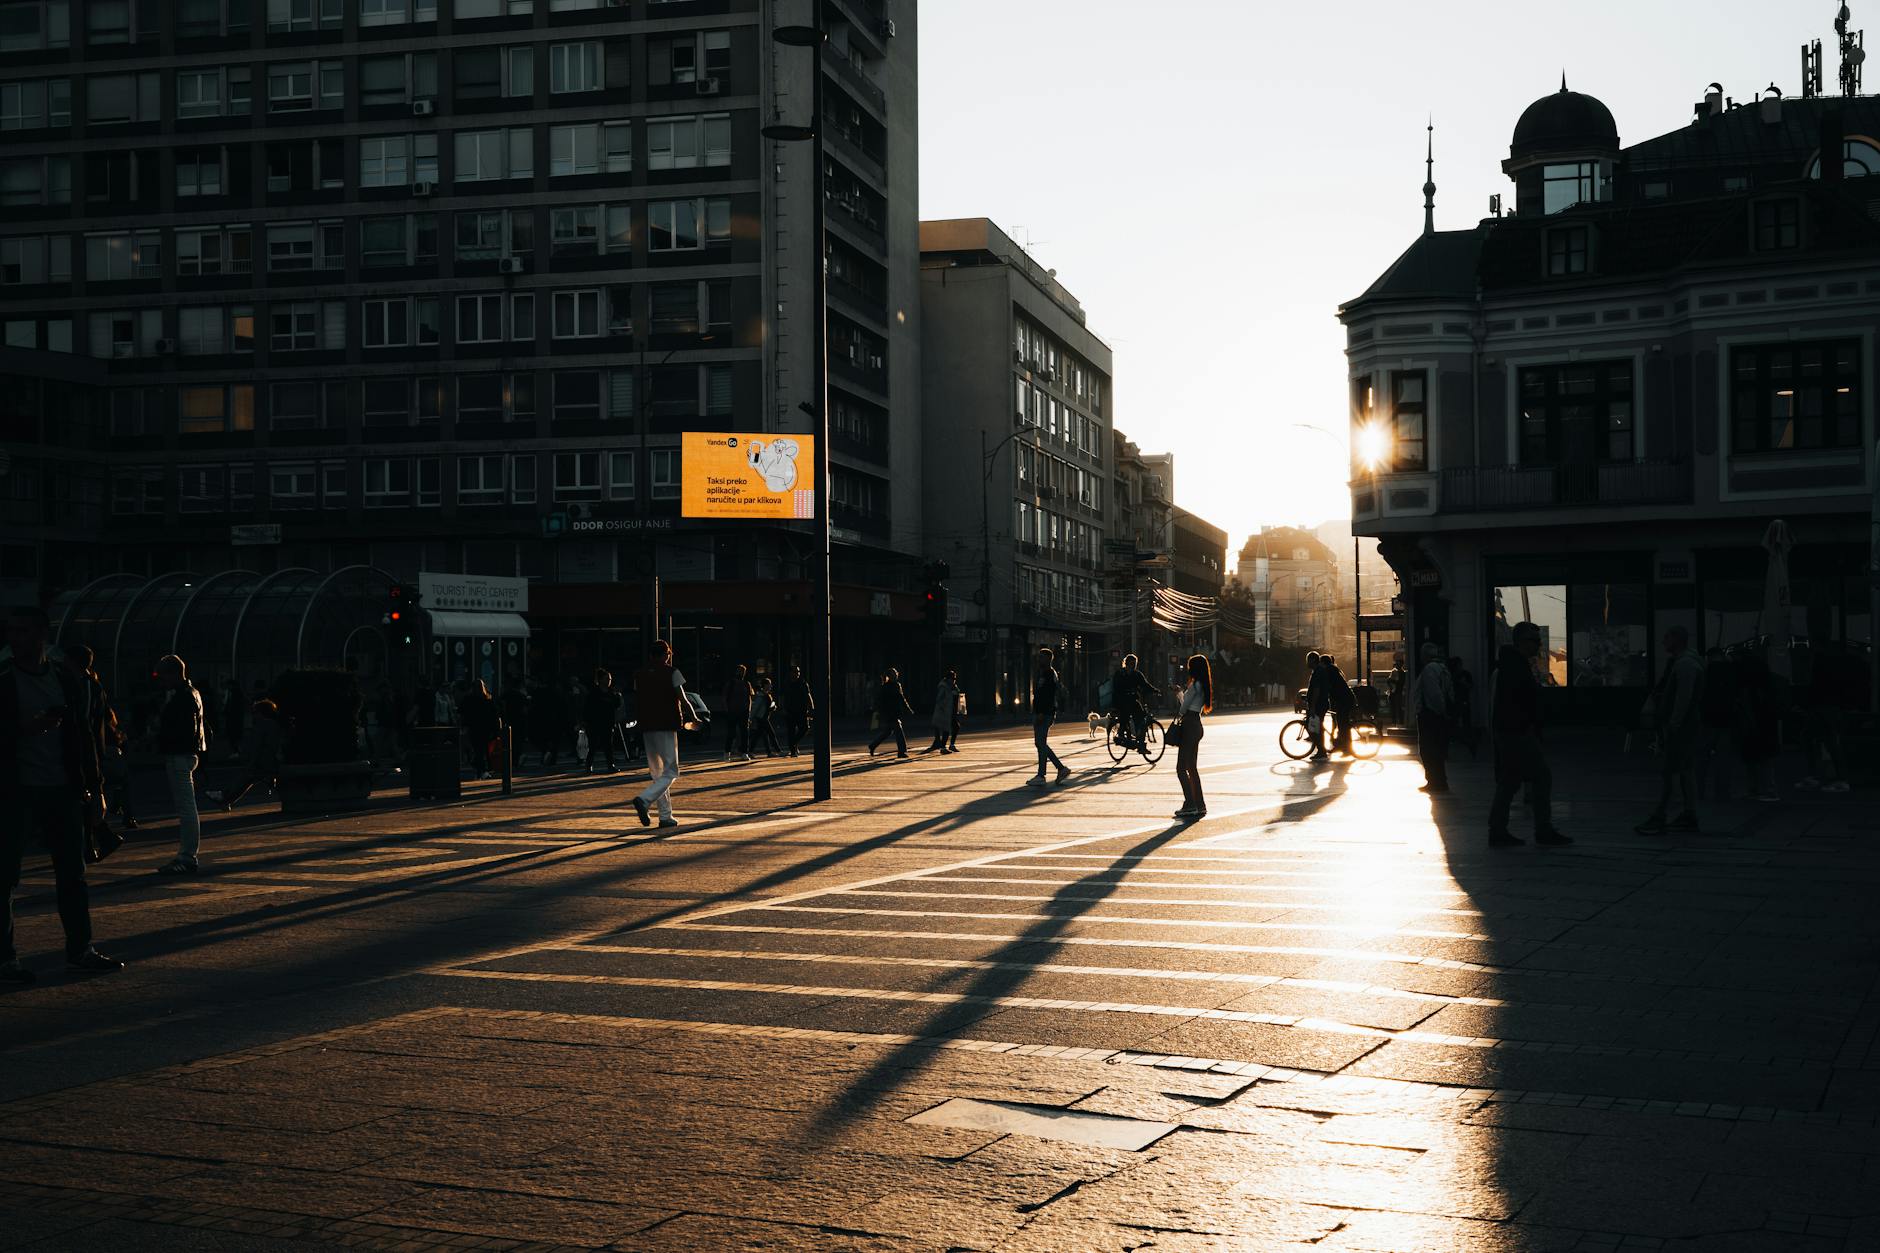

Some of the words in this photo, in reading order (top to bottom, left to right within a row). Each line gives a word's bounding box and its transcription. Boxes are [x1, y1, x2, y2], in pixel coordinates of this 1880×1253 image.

[729, 438, 737, 447] Go
[707, 477, 725, 485] Taksi
[726, 477, 747, 486] preko
[706, 487, 740, 495] aplikacije
[757, 496, 782, 504] klikova
[573, 521, 603, 530] DDOR
[432, 584, 465, 596] TOURIST
[469, 586, 487, 597] INFO
[489, 587, 519, 599] CENTER
